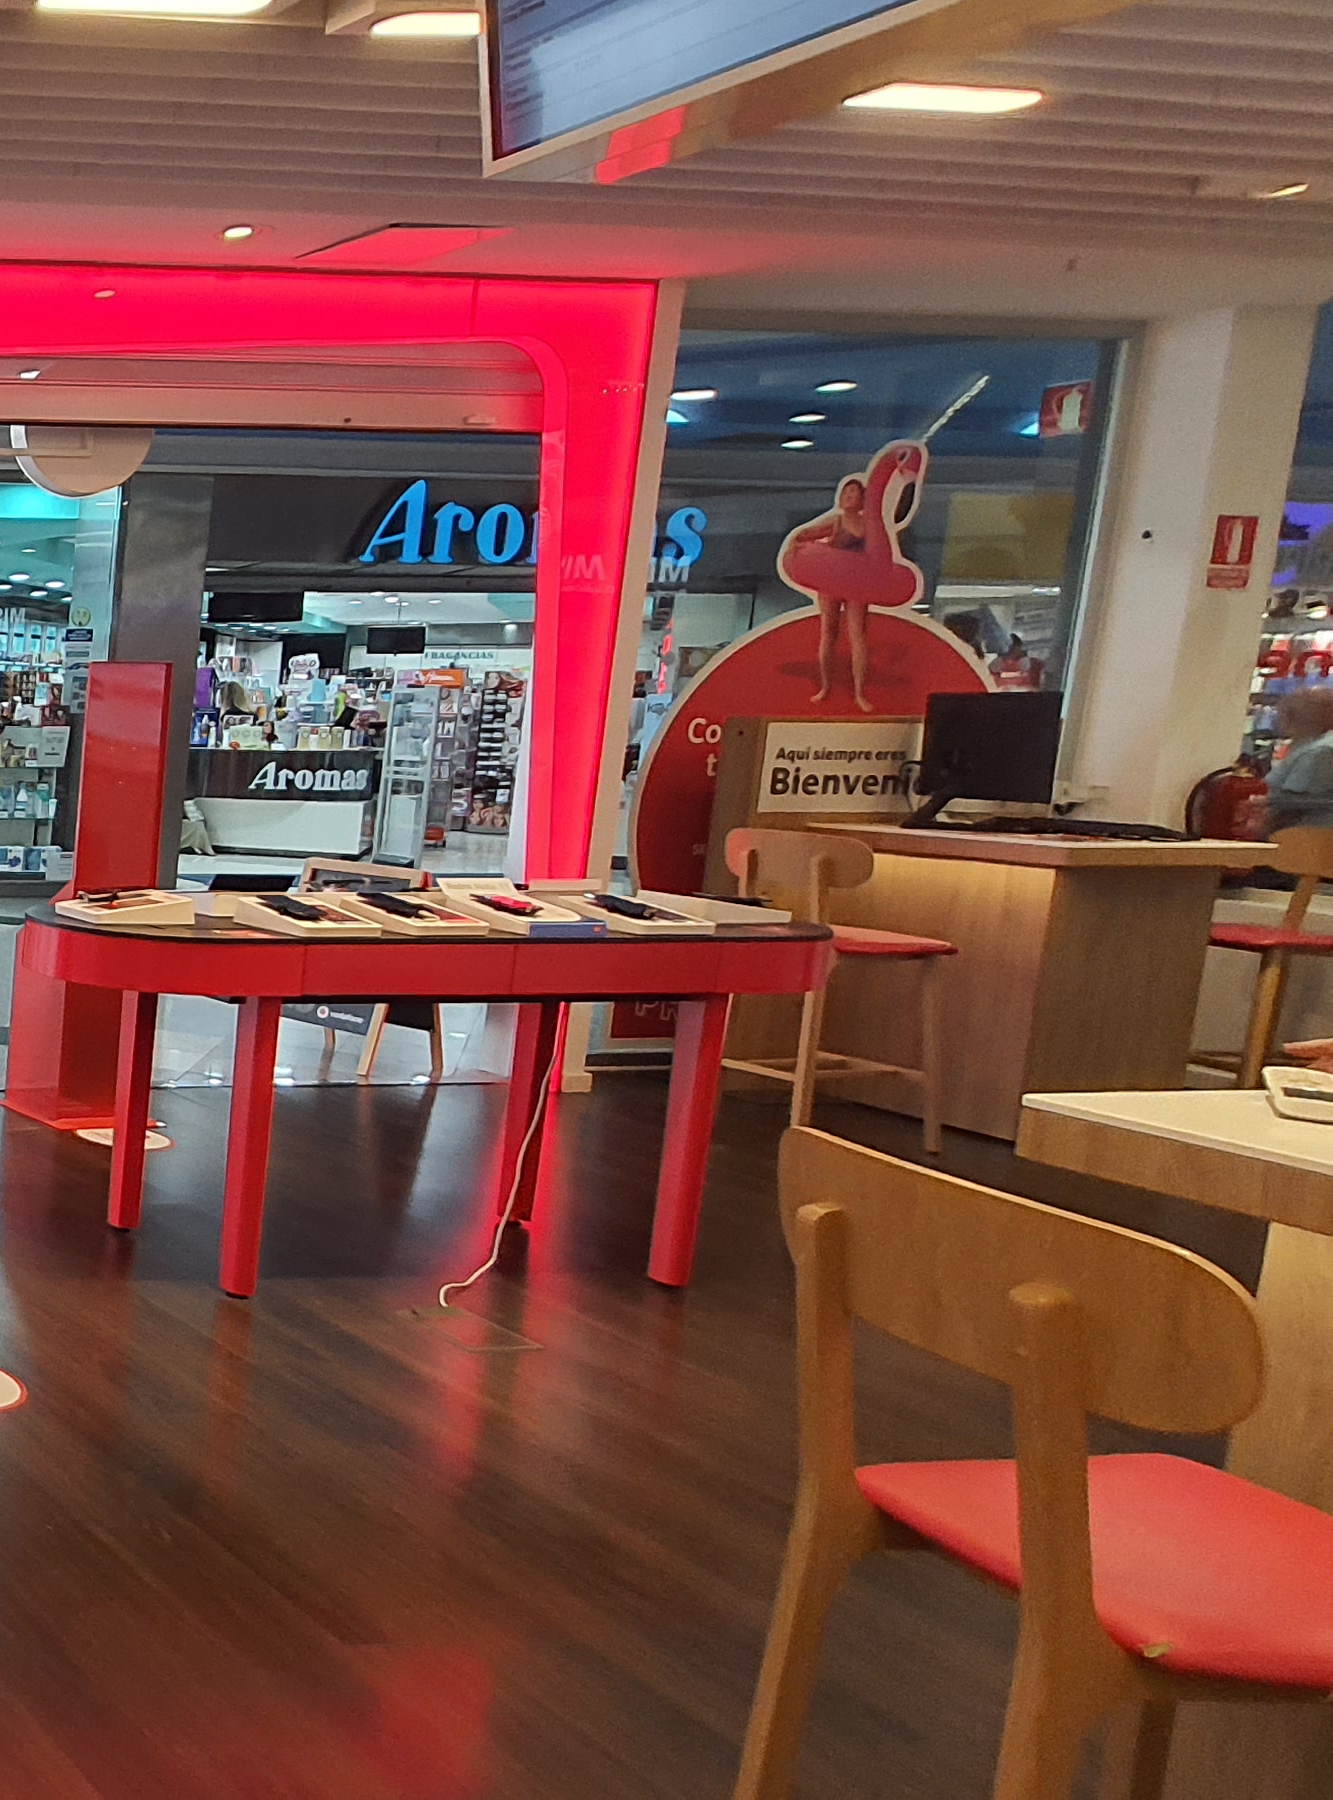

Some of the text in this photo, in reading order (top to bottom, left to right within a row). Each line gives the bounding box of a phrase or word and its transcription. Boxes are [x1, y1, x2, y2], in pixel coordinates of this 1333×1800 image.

[358, 479, 708, 567] Aros
[813, 747, 871, 763] siempre
[874, 750, 908, 762] eres
[248, 761, 368, 791] Aromas
